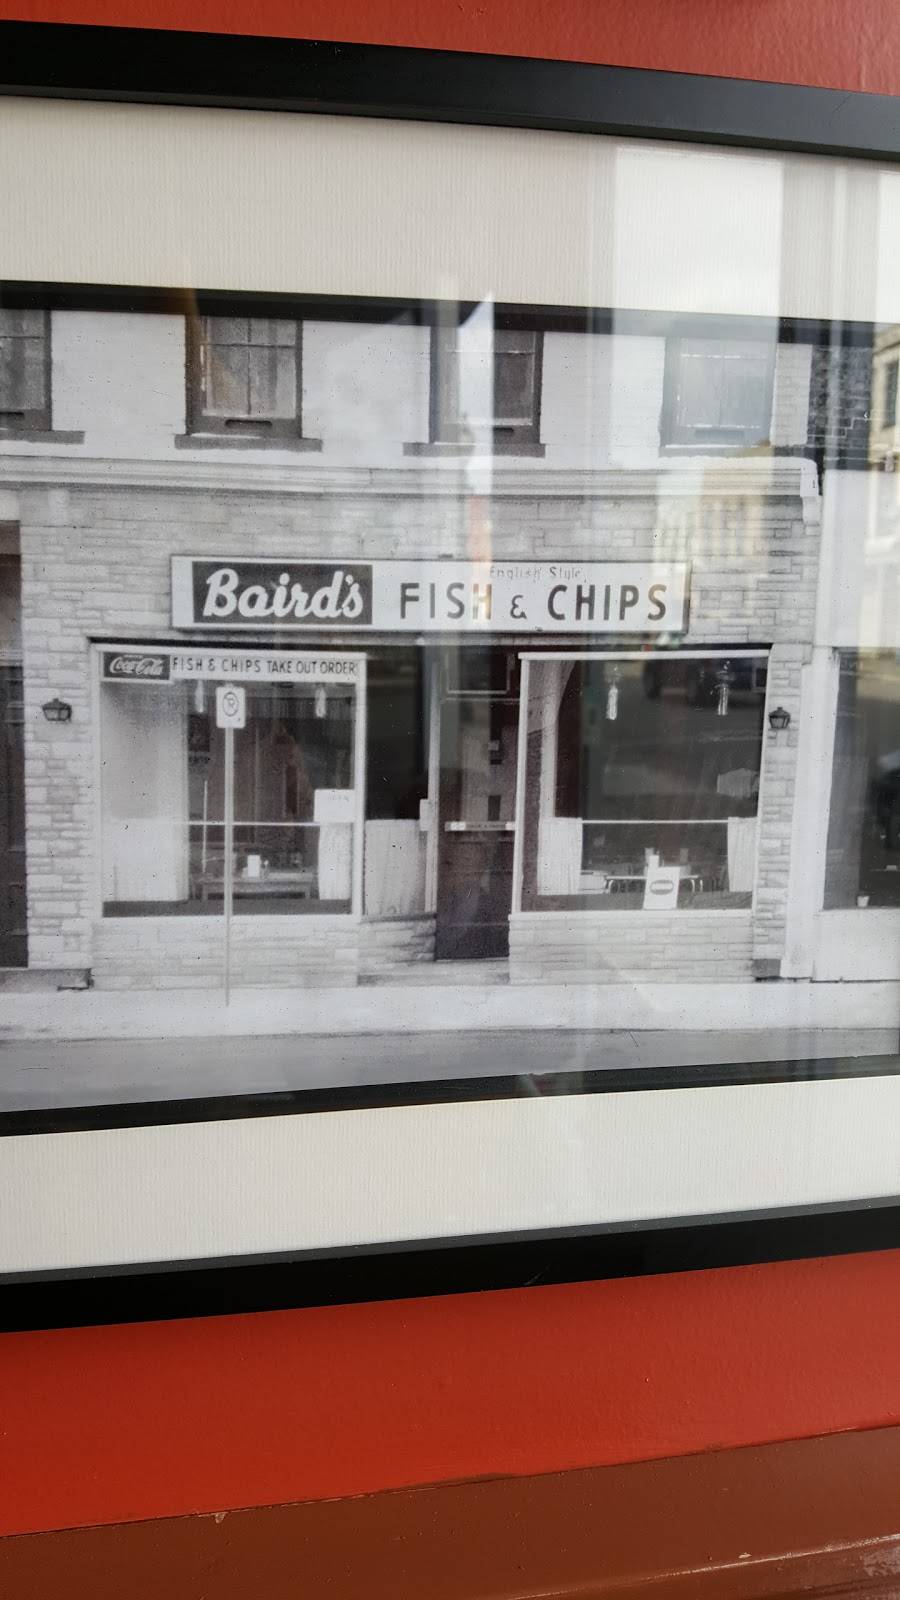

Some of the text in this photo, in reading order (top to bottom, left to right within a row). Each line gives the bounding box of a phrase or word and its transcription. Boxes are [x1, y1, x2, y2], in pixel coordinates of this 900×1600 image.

[203, 568, 363, 618] Baird's
[400, 582, 667, 621] FISH & CHIPS
[173, 657, 202, 671] FISH
[208, 658, 216, 671] &
[221, 659, 261, 673] CHIPS
[266, 660, 292, 674] TAKE
[296, 660, 317, 674] OUT
